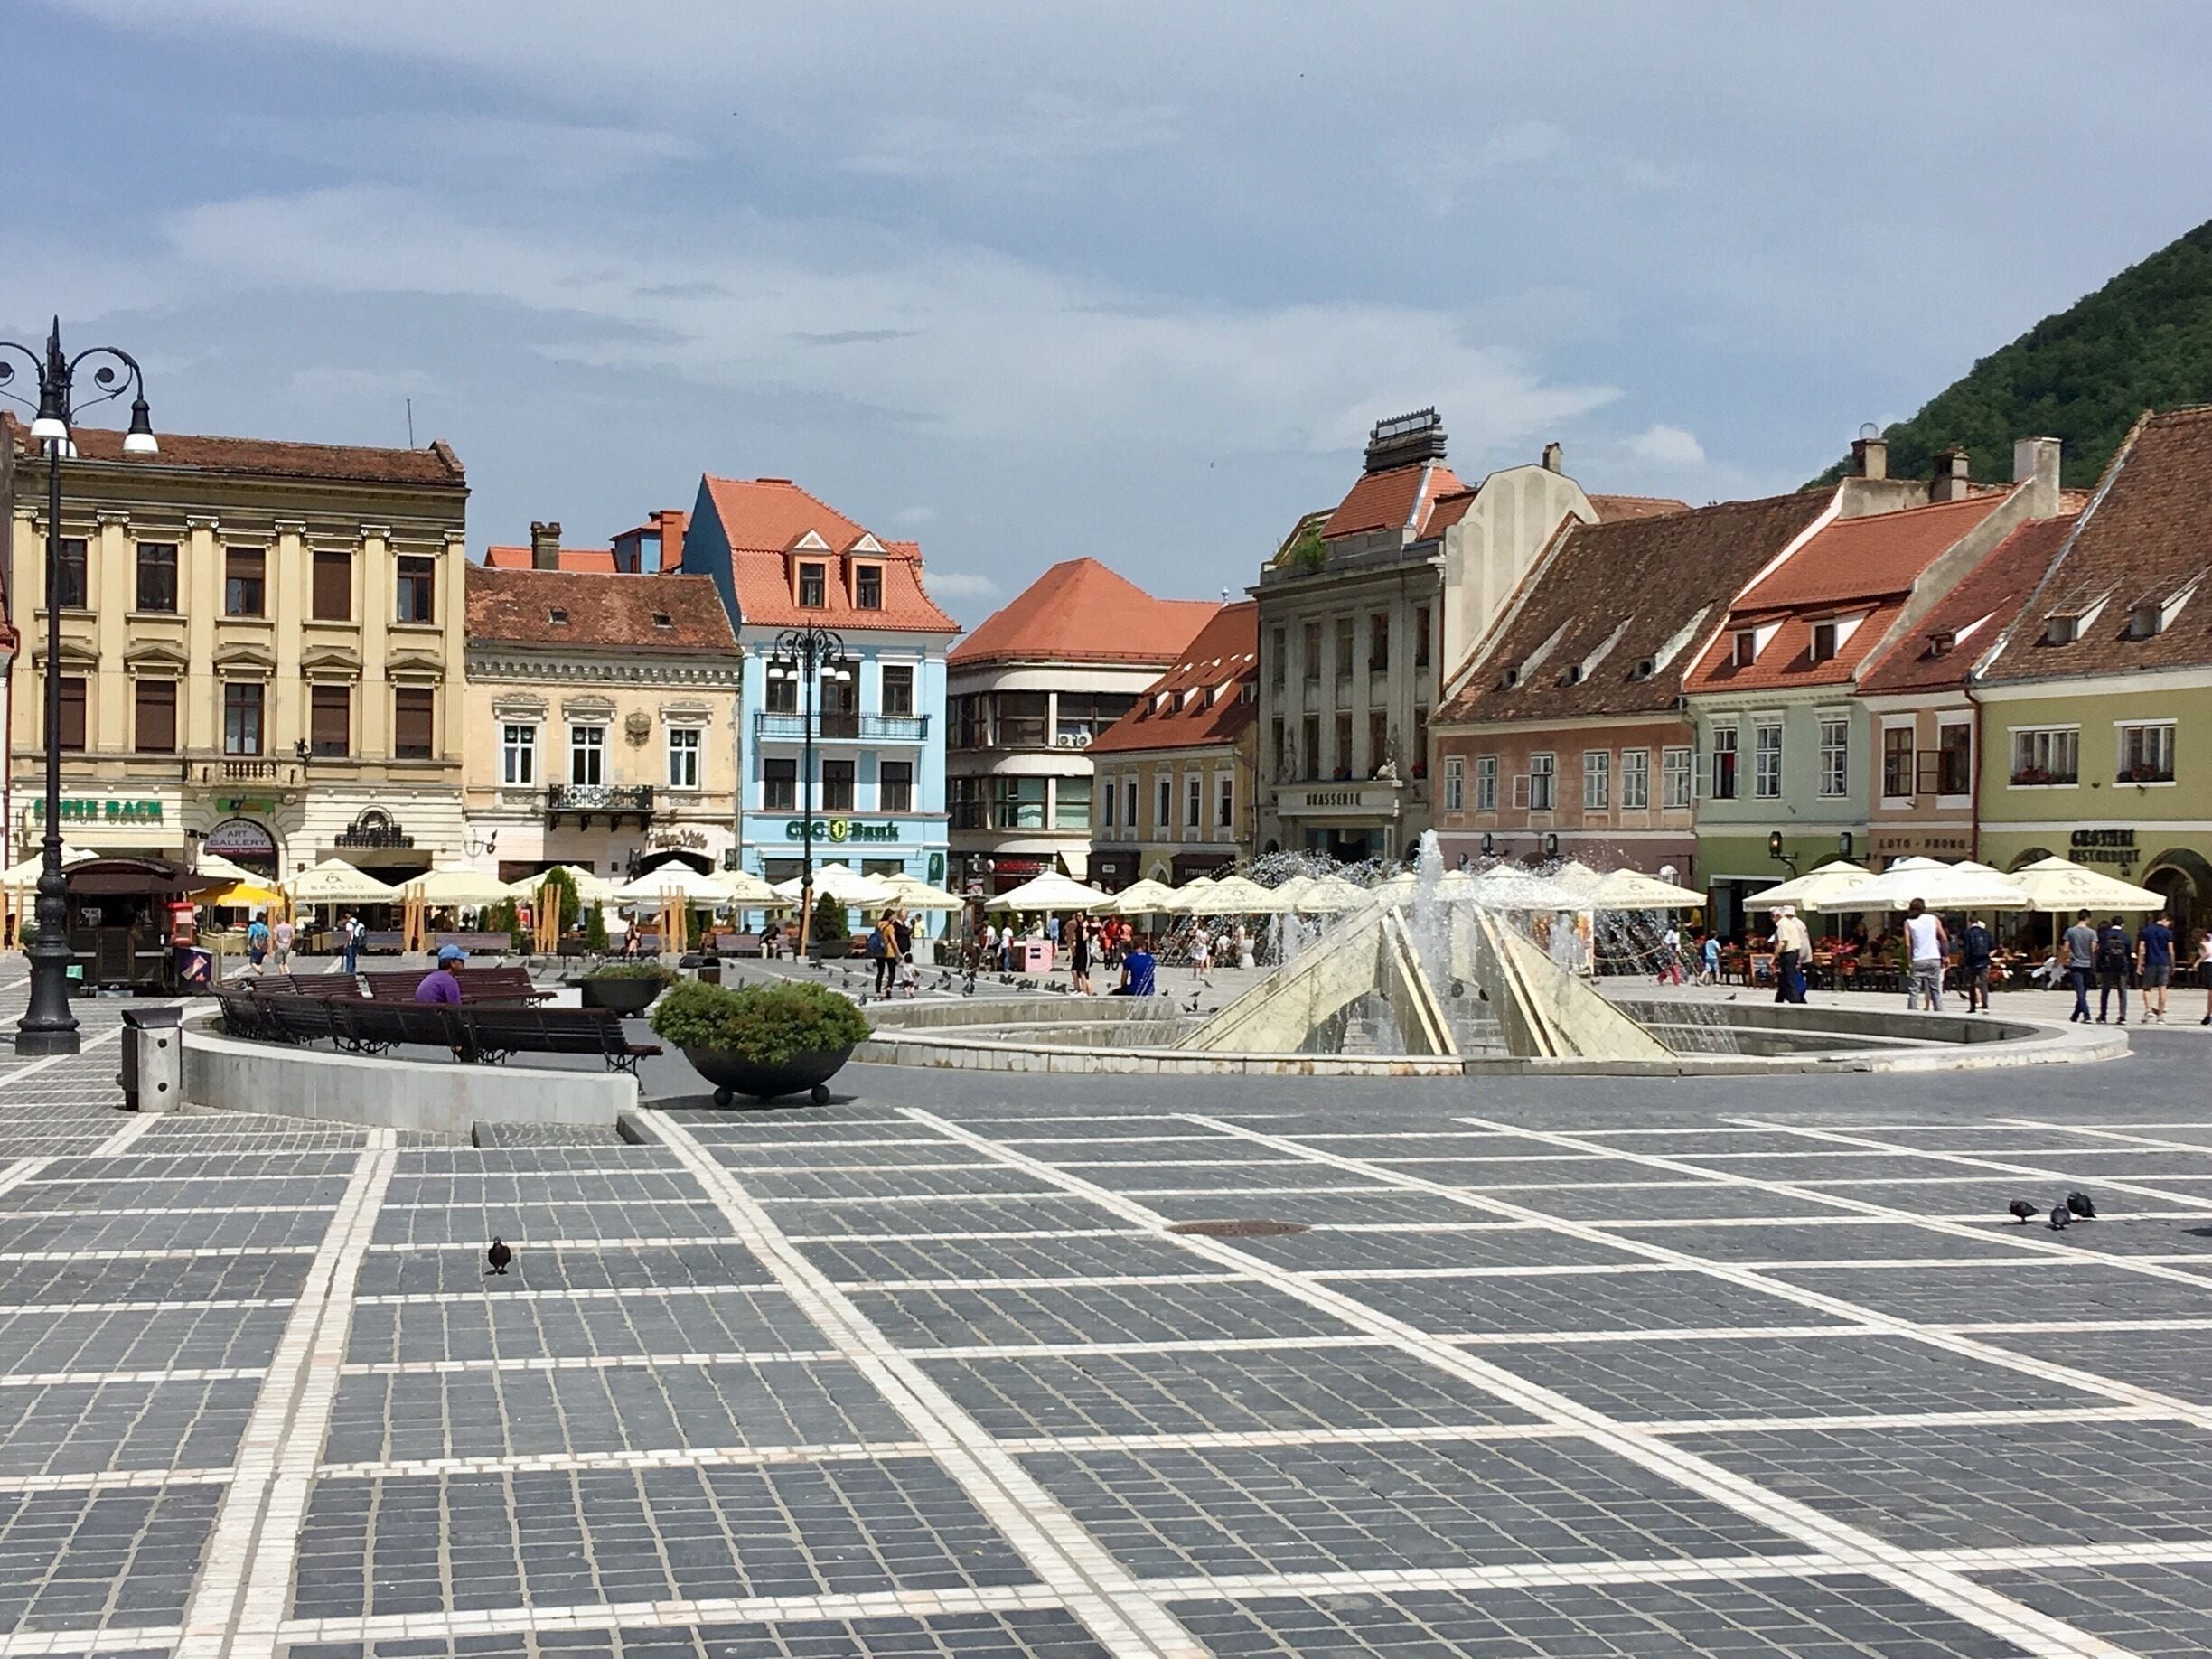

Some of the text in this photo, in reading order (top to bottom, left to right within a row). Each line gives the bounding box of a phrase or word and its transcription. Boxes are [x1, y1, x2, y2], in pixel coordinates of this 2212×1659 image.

[1306, 793, 1361, 806] BRASSERIE
[849, 820, 899, 839] Bank
[1879, 839, 1911, 849] LOTO
